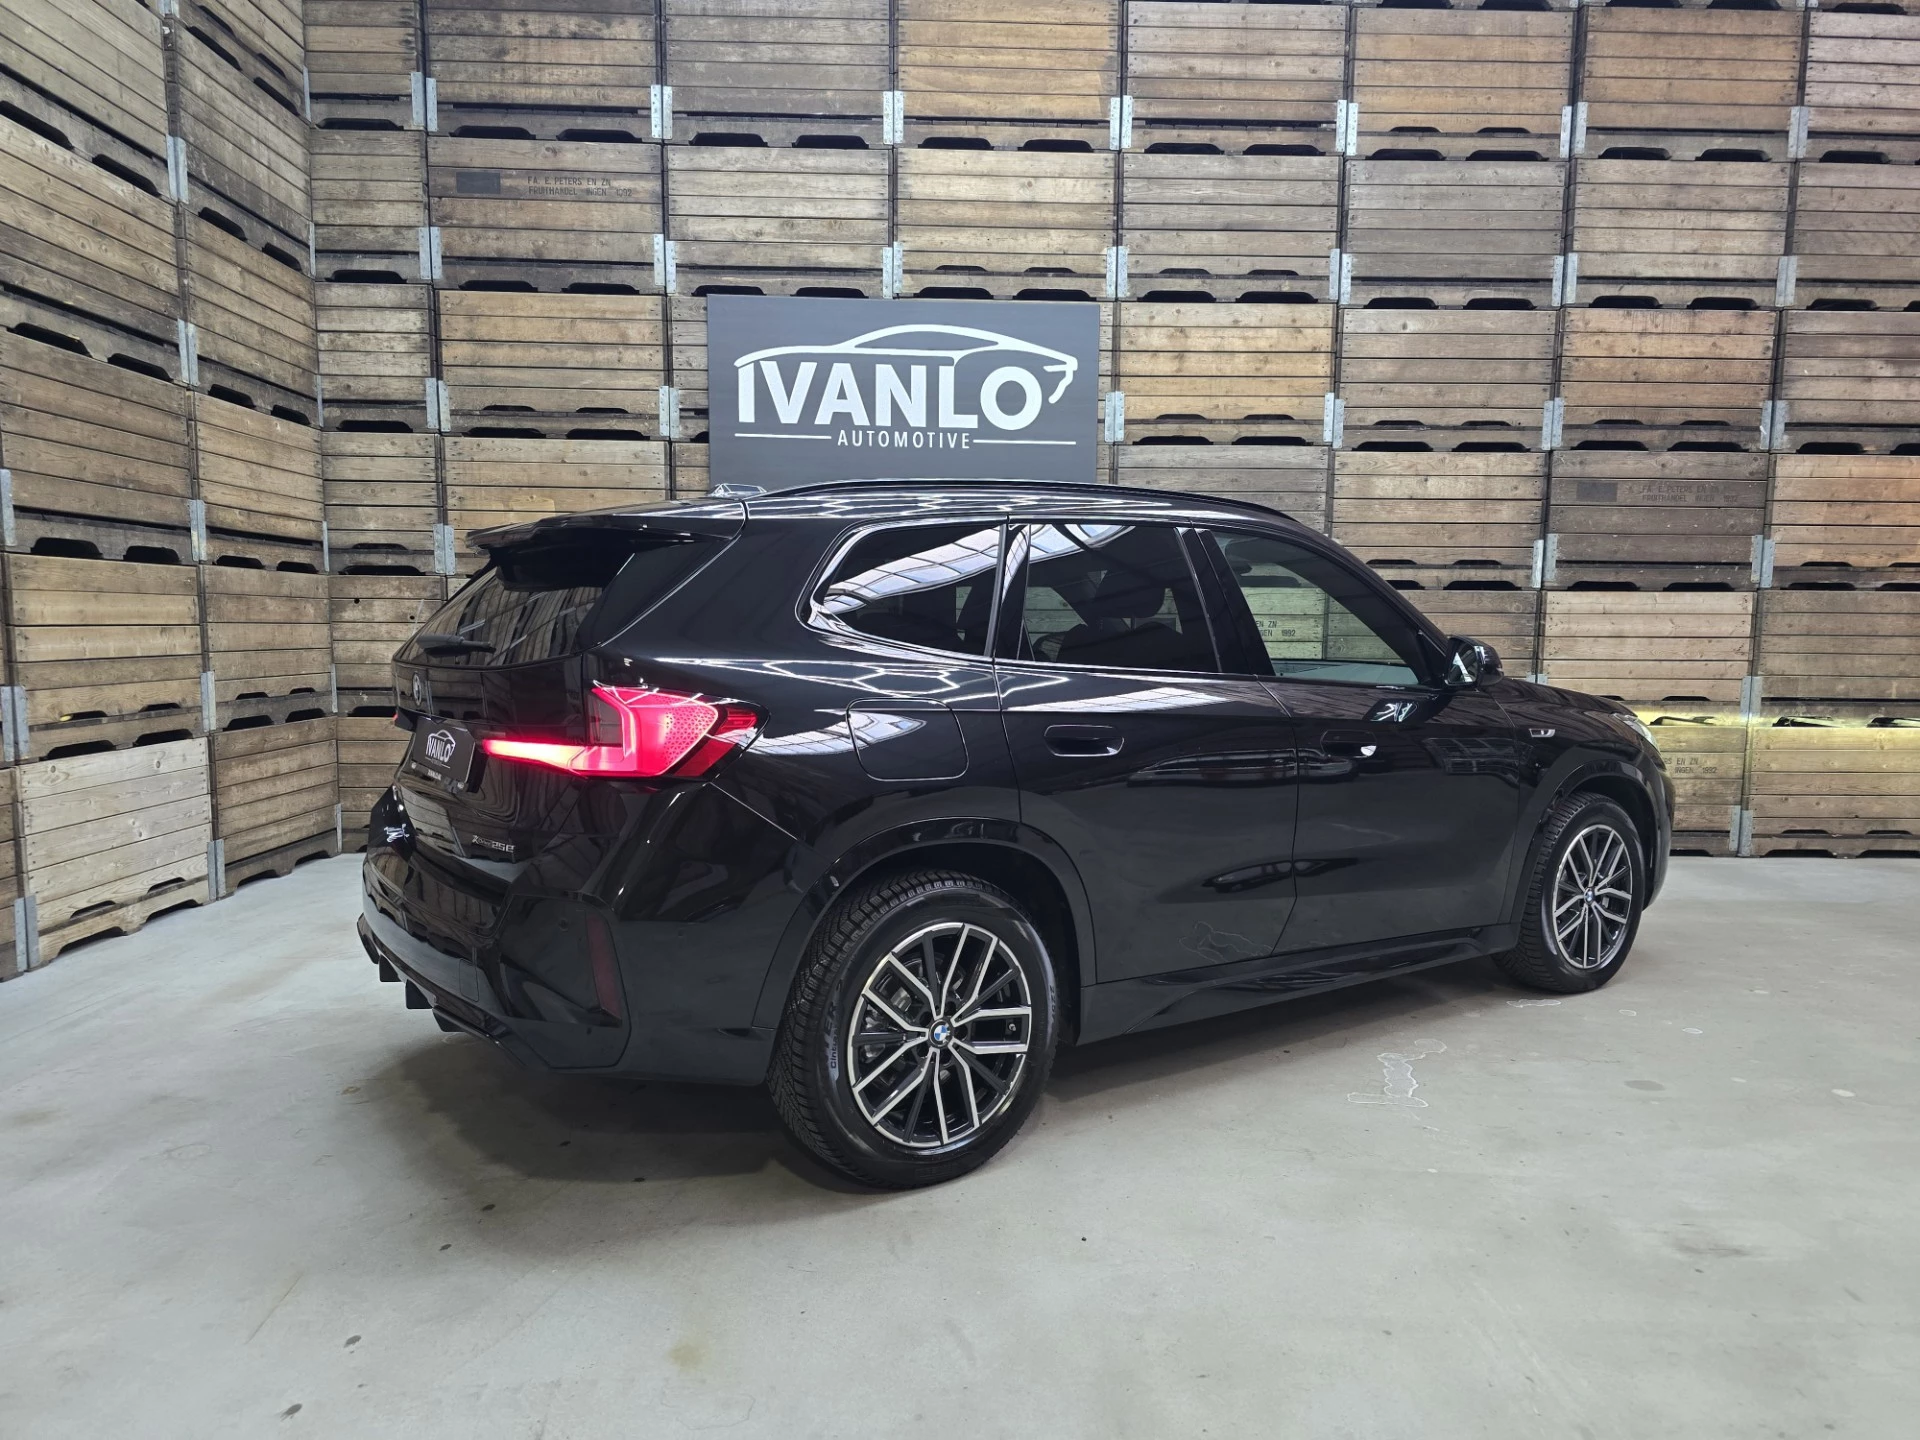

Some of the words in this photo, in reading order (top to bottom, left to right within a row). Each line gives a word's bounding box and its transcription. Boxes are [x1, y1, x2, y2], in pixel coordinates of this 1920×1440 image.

[554, 176, 583, 186] PETERS
[586, 178, 597, 186] EN
[601, 178, 611, 187] ZN
[738, 360, 1043, 431] IVANLO
[837, 429, 971, 449] AUTOMOTIVE
[1267, 620, 1278, 628] ZN
